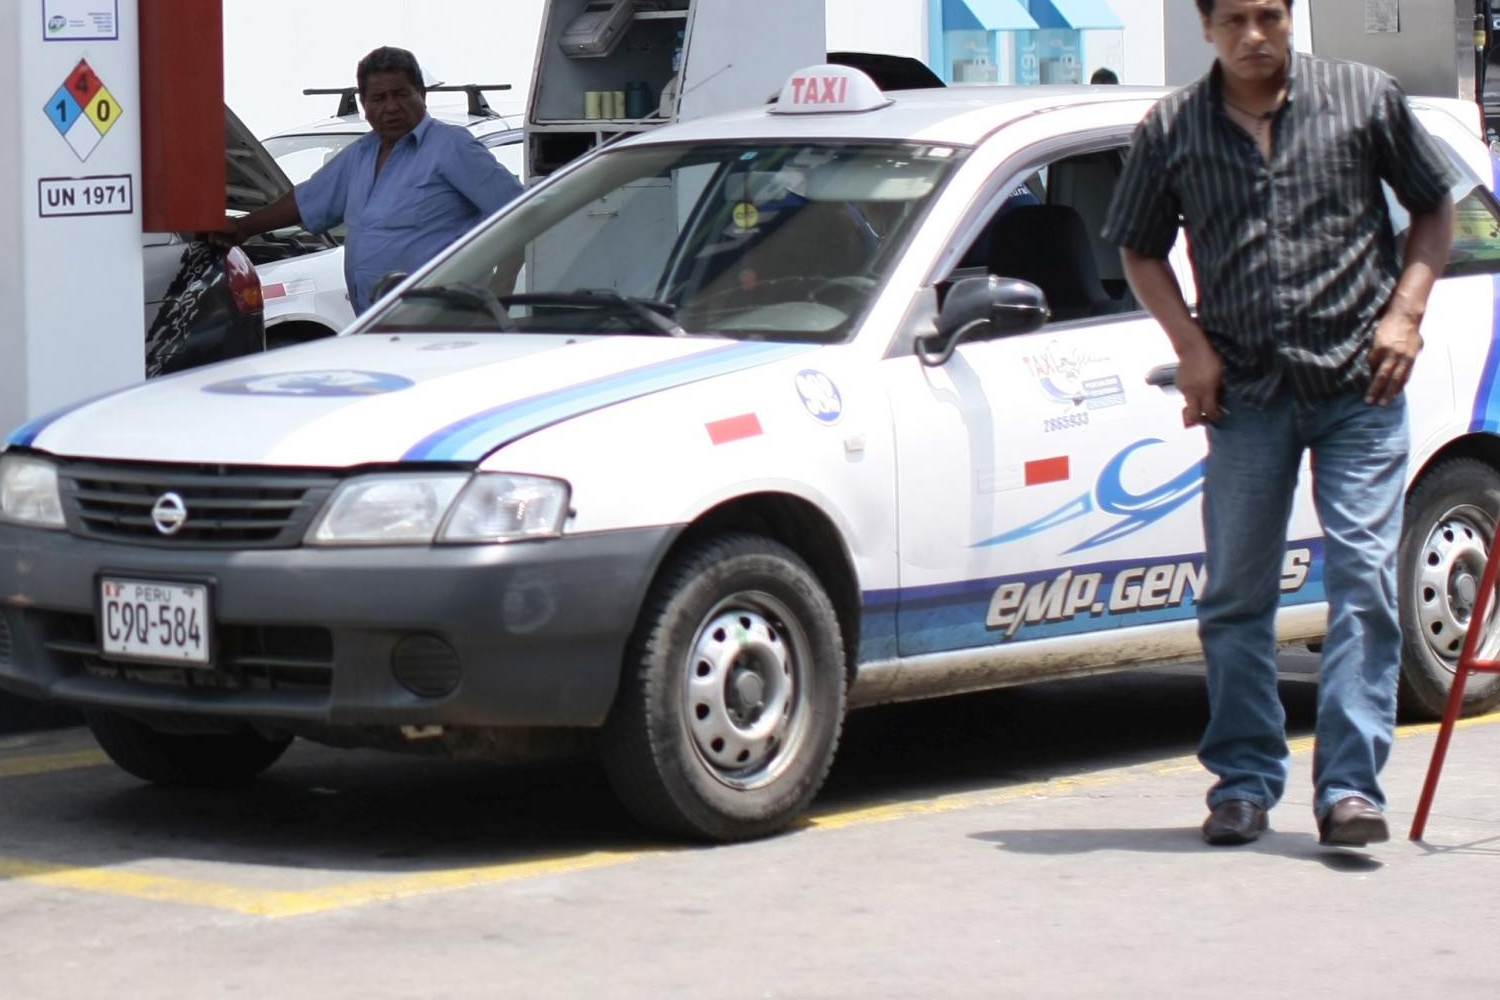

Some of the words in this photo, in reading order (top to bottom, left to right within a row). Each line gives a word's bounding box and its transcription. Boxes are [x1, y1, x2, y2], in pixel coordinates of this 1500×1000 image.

[75, 73, 88, 93] 4
[790, 76, 848, 103] TAXI
[56, 100, 67, 122] 1
[97, 99, 110, 122] 0
[47, 187, 75, 206] UN
[82, 185, 127, 205] 1971
[135, 586, 172, 602] PERU
[107, 600, 201, 649] C9Q-584
